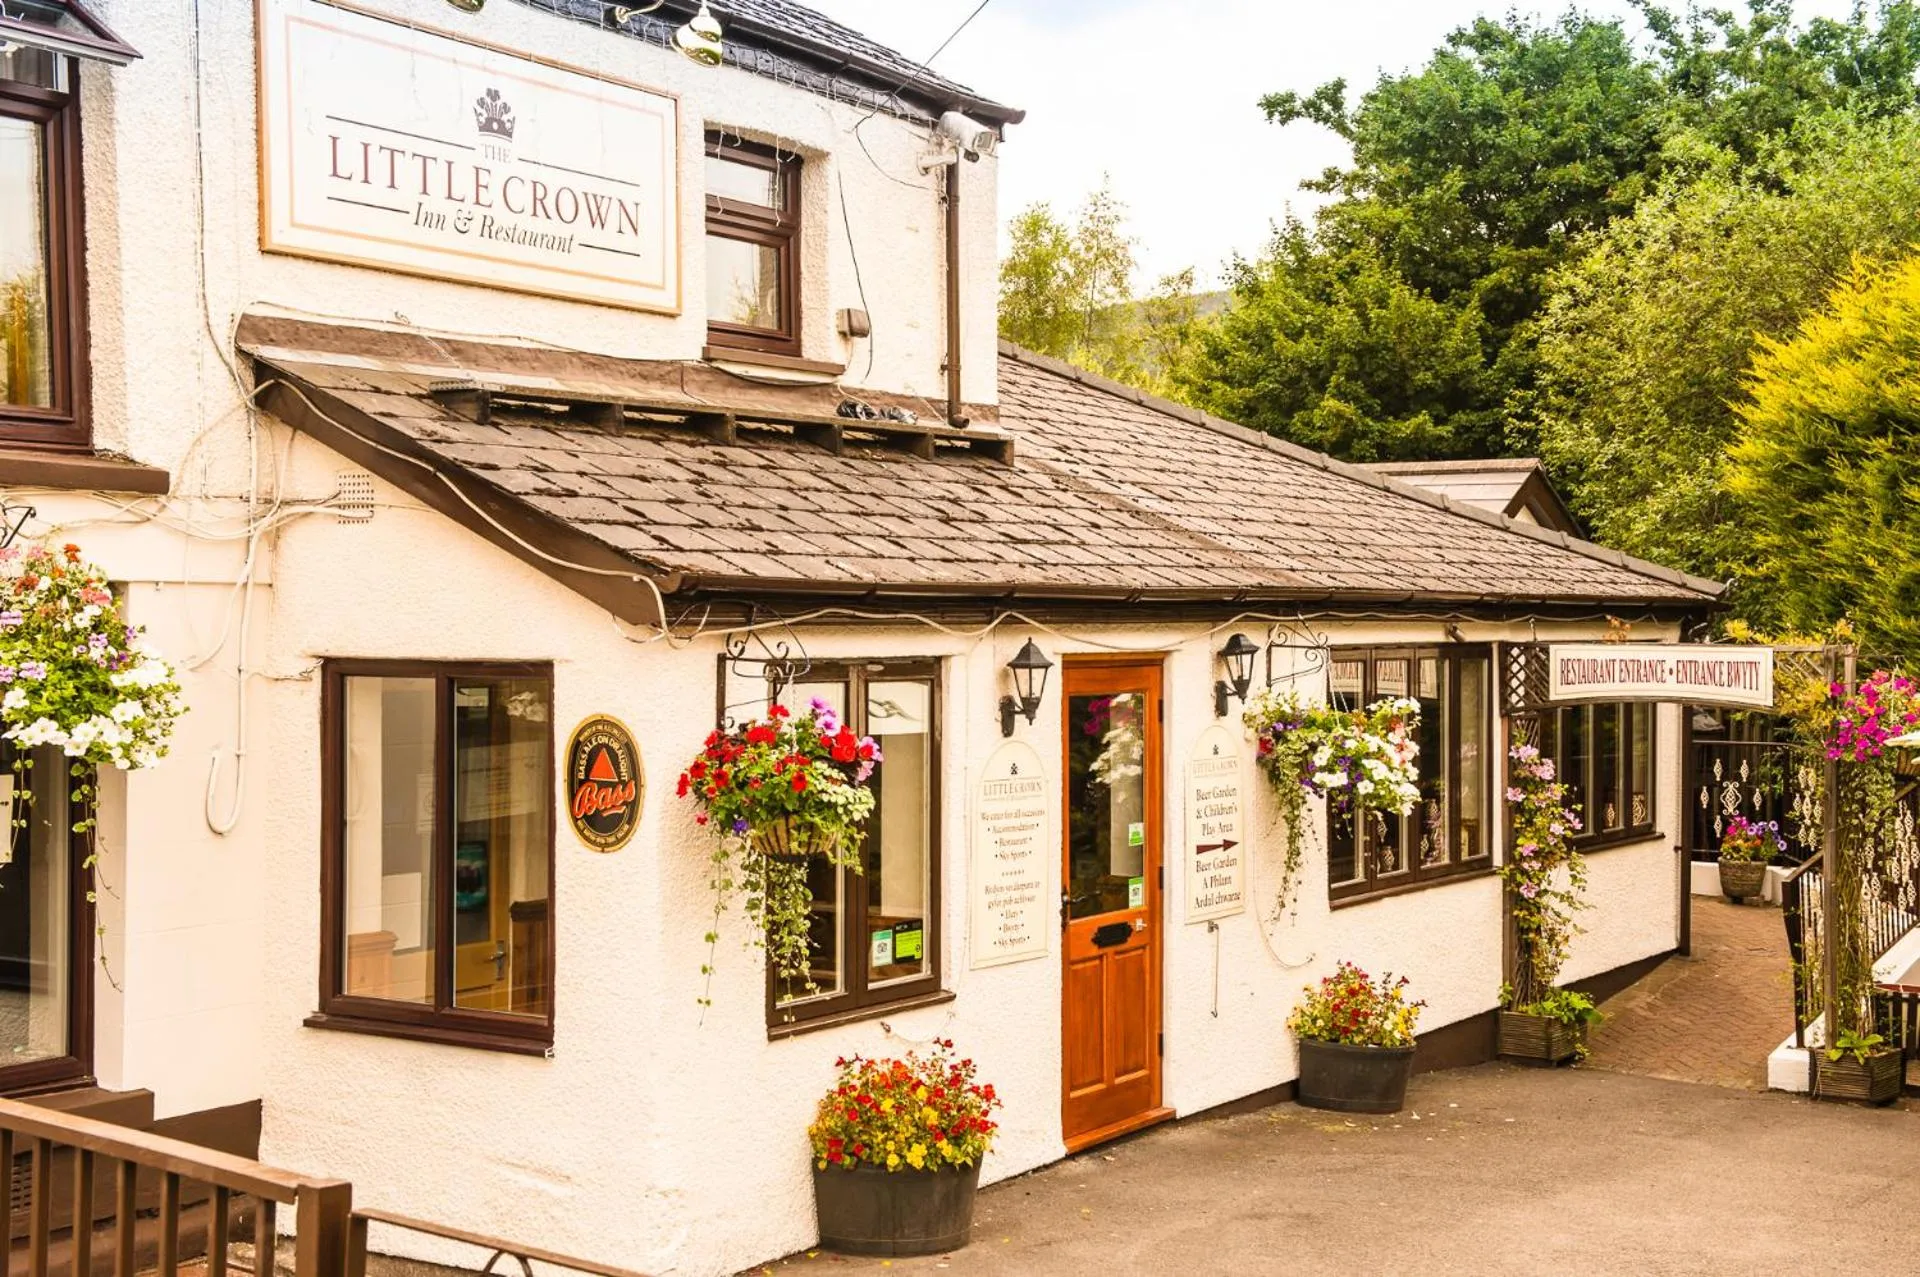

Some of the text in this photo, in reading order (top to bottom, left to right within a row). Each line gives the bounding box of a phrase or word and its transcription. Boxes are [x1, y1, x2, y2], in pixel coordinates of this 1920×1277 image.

[481, 142, 511, 164] THE
[328, 135, 641, 237] LITTLE CROWN
[413, 202, 576, 255] Inn & Restaurant
[1560, 658, 1761, 691] RESTAURANT ENTRANCE ENTRANCE BWYTY
[577, 735, 628, 782] BASS ALE ON DRAUGHT
[983, 781, 1042, 796] LITTLE CROWN
[1196, 785, 1237, 801] Beer Garden
[572, 779, 636, 818] Bass
[1196, 802, 1238, 820] & Children's
[1201, 821, 1234, 837] Play Area
[1196, 857, 1237, 873] Beer Garden
[1202, 877, 1208, 889] A
[1194, 892, 1214, 909] Ardal
